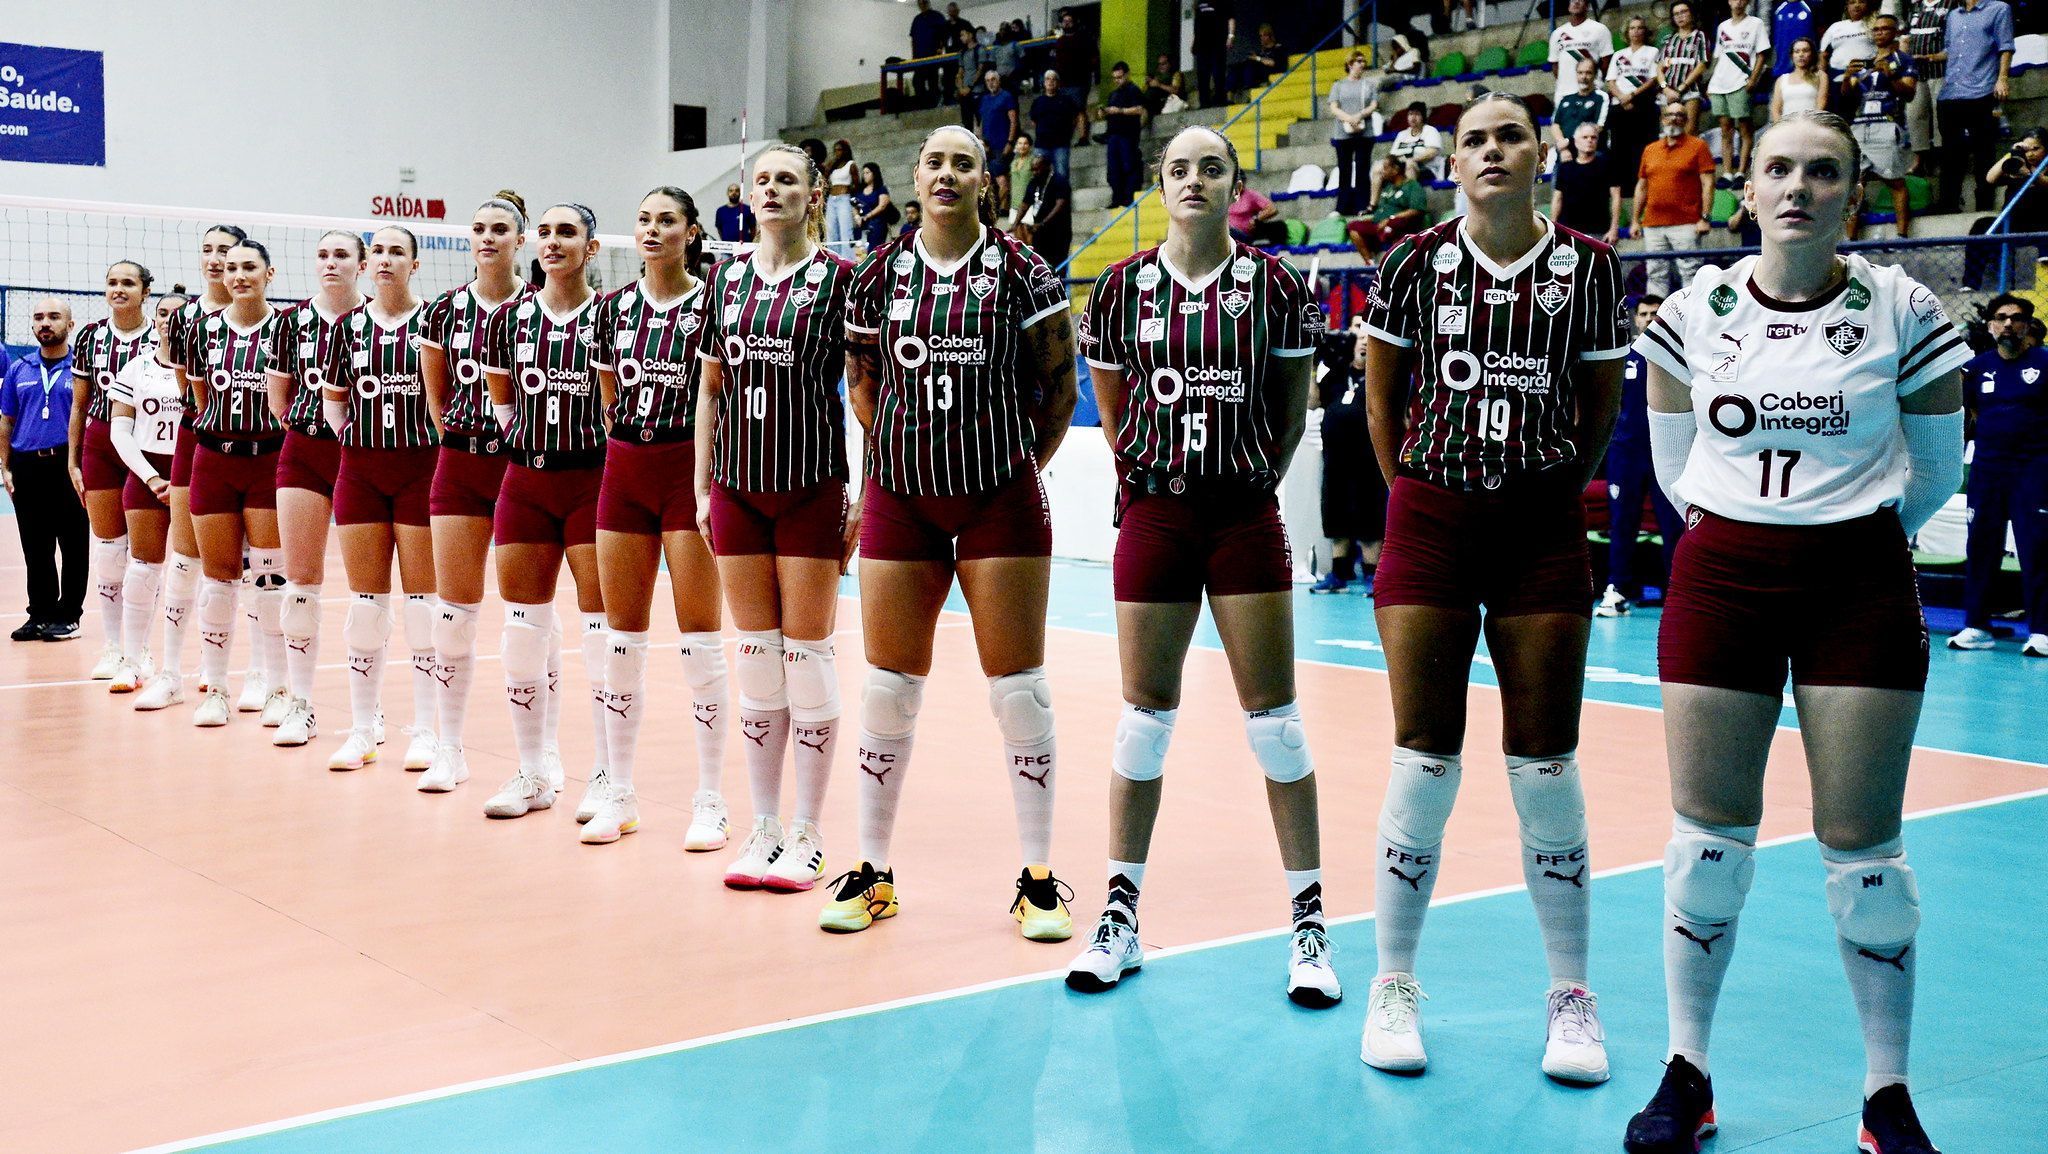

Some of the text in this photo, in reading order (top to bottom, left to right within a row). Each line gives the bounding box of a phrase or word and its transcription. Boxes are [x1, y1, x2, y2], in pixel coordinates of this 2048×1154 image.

[0, 86, 80, 113] Saúde.
[371, 194, 425, 218] SAÍDA
[1433, 258, 1460, 267] campo
[1435, 251, 1458, 259] verde
[1552, 253, 1575, 261] verde
[1550, 260, 1577, 269] campo
[932, 283, 960, 294] rentv
[1485, 289, 1521, 303] rentv
[1180, 301, 1210, 312] rentv
[1767, 323, 1808, 337] rentv
[746, 333, 793, 353] Caberj
[928, 334, 983, 351] Caberj
[747, 347, 795, 365] Integral
[929, 349, 986, 365] Integral
[1483, 351, 1549, 375] Caberj
[642, 358, 687, 376] Caberj
[381, 371, 418, 384] Caberj
[547, 368, 590, 384] Caberj
[641, 370, 687, 386] Integral
[1184, 366, 1242, 386] Caberj
[1483, 370, 1551, 392] Integral
[381, 380, 421, 395] Integral
[547, 379, 591, 394] Integral
[924, 375, 954, 411] 13
[1185, 383, 1245, 400] Integral
[232, 391, 243, 414] 2
[638, 386, 653, 417] 9
[744, 386, 767, 419] 10
[1759, 390, 1844, 415] Caberj
[383, 403, 395, 428] 6
[547, 396, 560, 425] 8
[1477, 398, 1511, 442] 19
[1760, 411, 1850, 434] Integral
[157, 421, 174, 441] 21
[1181, 412, 1208, 452] 15
[1821, 429, 1848, 437] saúde
[1758, 449, 1801, 498] 17
[507, 686, 536, 695] FFC
[604, 691, 633, 702] FFC
[741, 716, 770, 729] FFC
[796, 726, 830, 738] FFC
[859, 747, 896, 763] FFC
[1015, 753, 1051, 766] FFC
[1386, 846, 1431, 866] FFC
[1536, 848, 1585, 866] FFC
